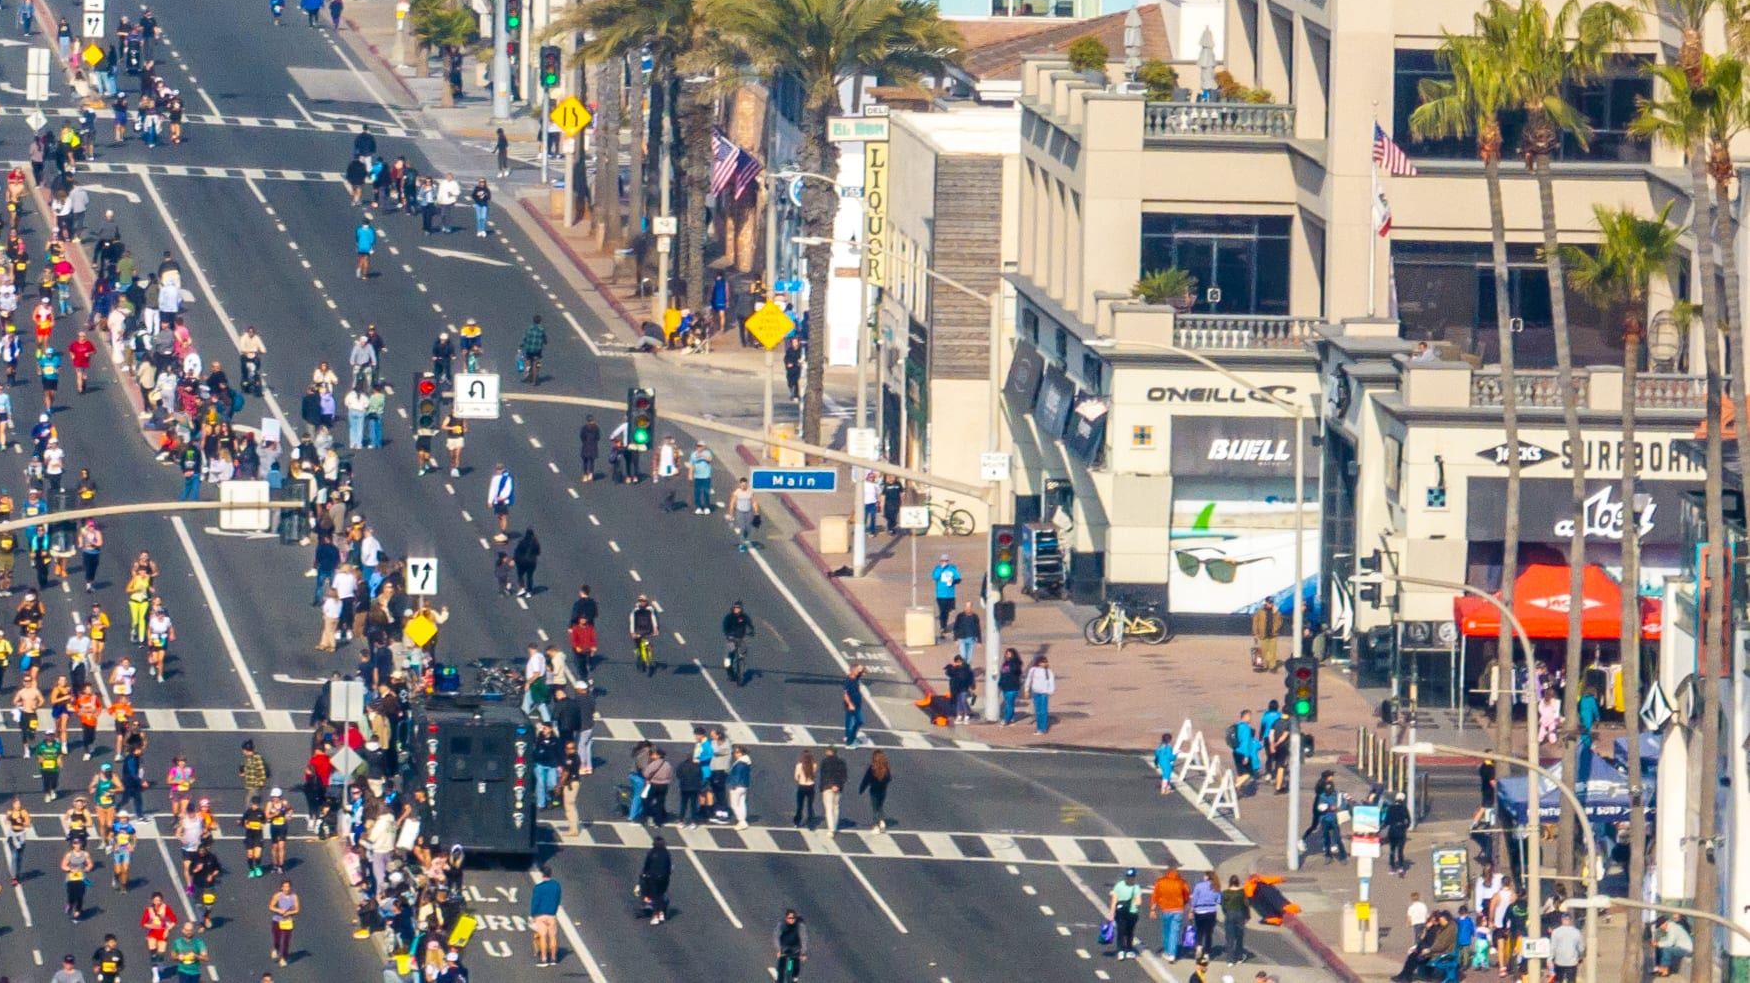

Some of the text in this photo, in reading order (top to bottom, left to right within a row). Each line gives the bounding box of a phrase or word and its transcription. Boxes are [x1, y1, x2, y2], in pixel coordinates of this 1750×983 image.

[868, 148, 885, 280] LIQUOR
[1207, 438, 1291, 461] BUELL
[772, 475, 816, 487] Main
[482, 941, 513, 958] U
